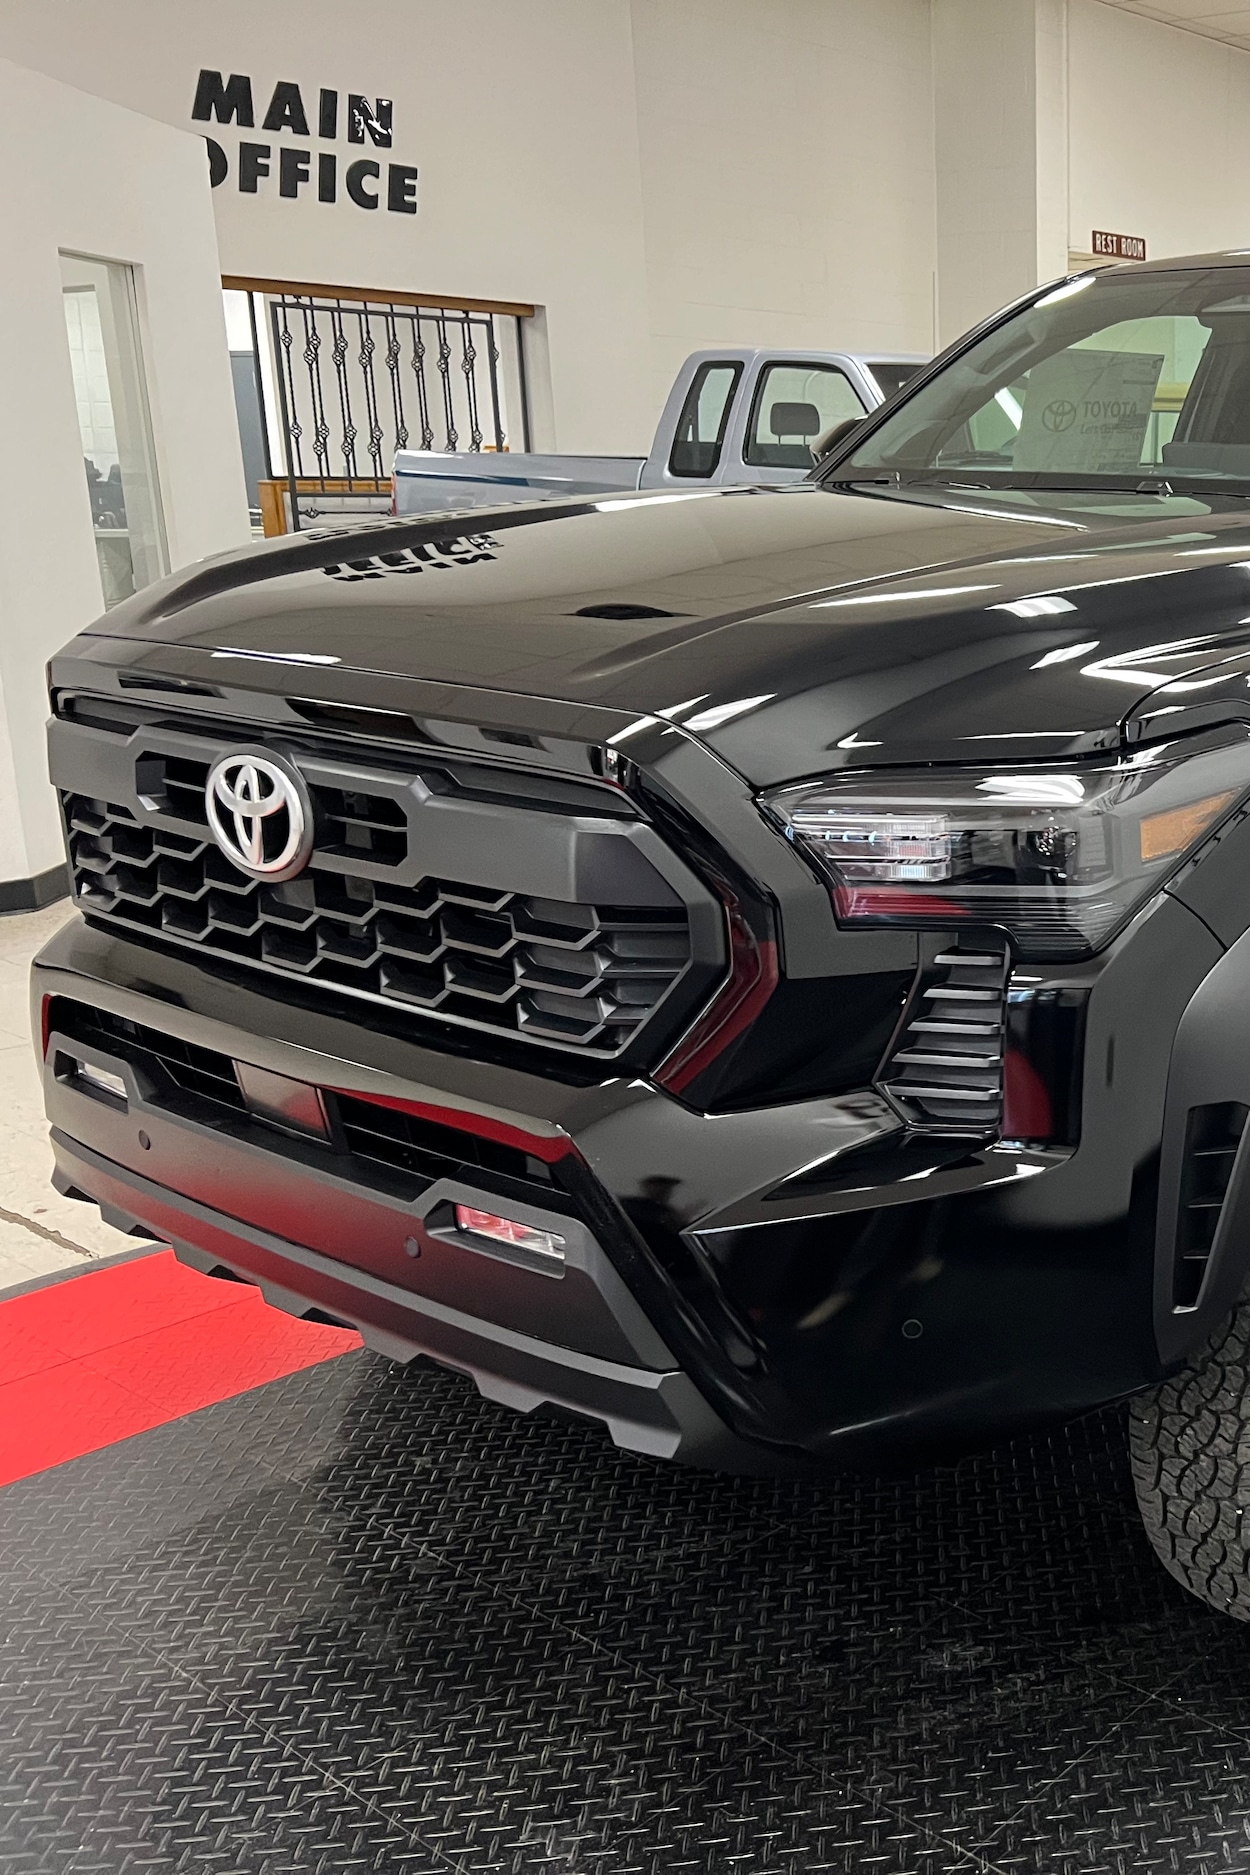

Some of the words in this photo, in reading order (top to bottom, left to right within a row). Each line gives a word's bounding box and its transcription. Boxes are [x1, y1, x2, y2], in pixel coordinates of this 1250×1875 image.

[191, 69, 393, 149] MAIN
[1095, 233, 1117, 253] REST
[1121, 237, 1143, 257] ROOM
[1084, 401, 1137, 418] TOYOTA
